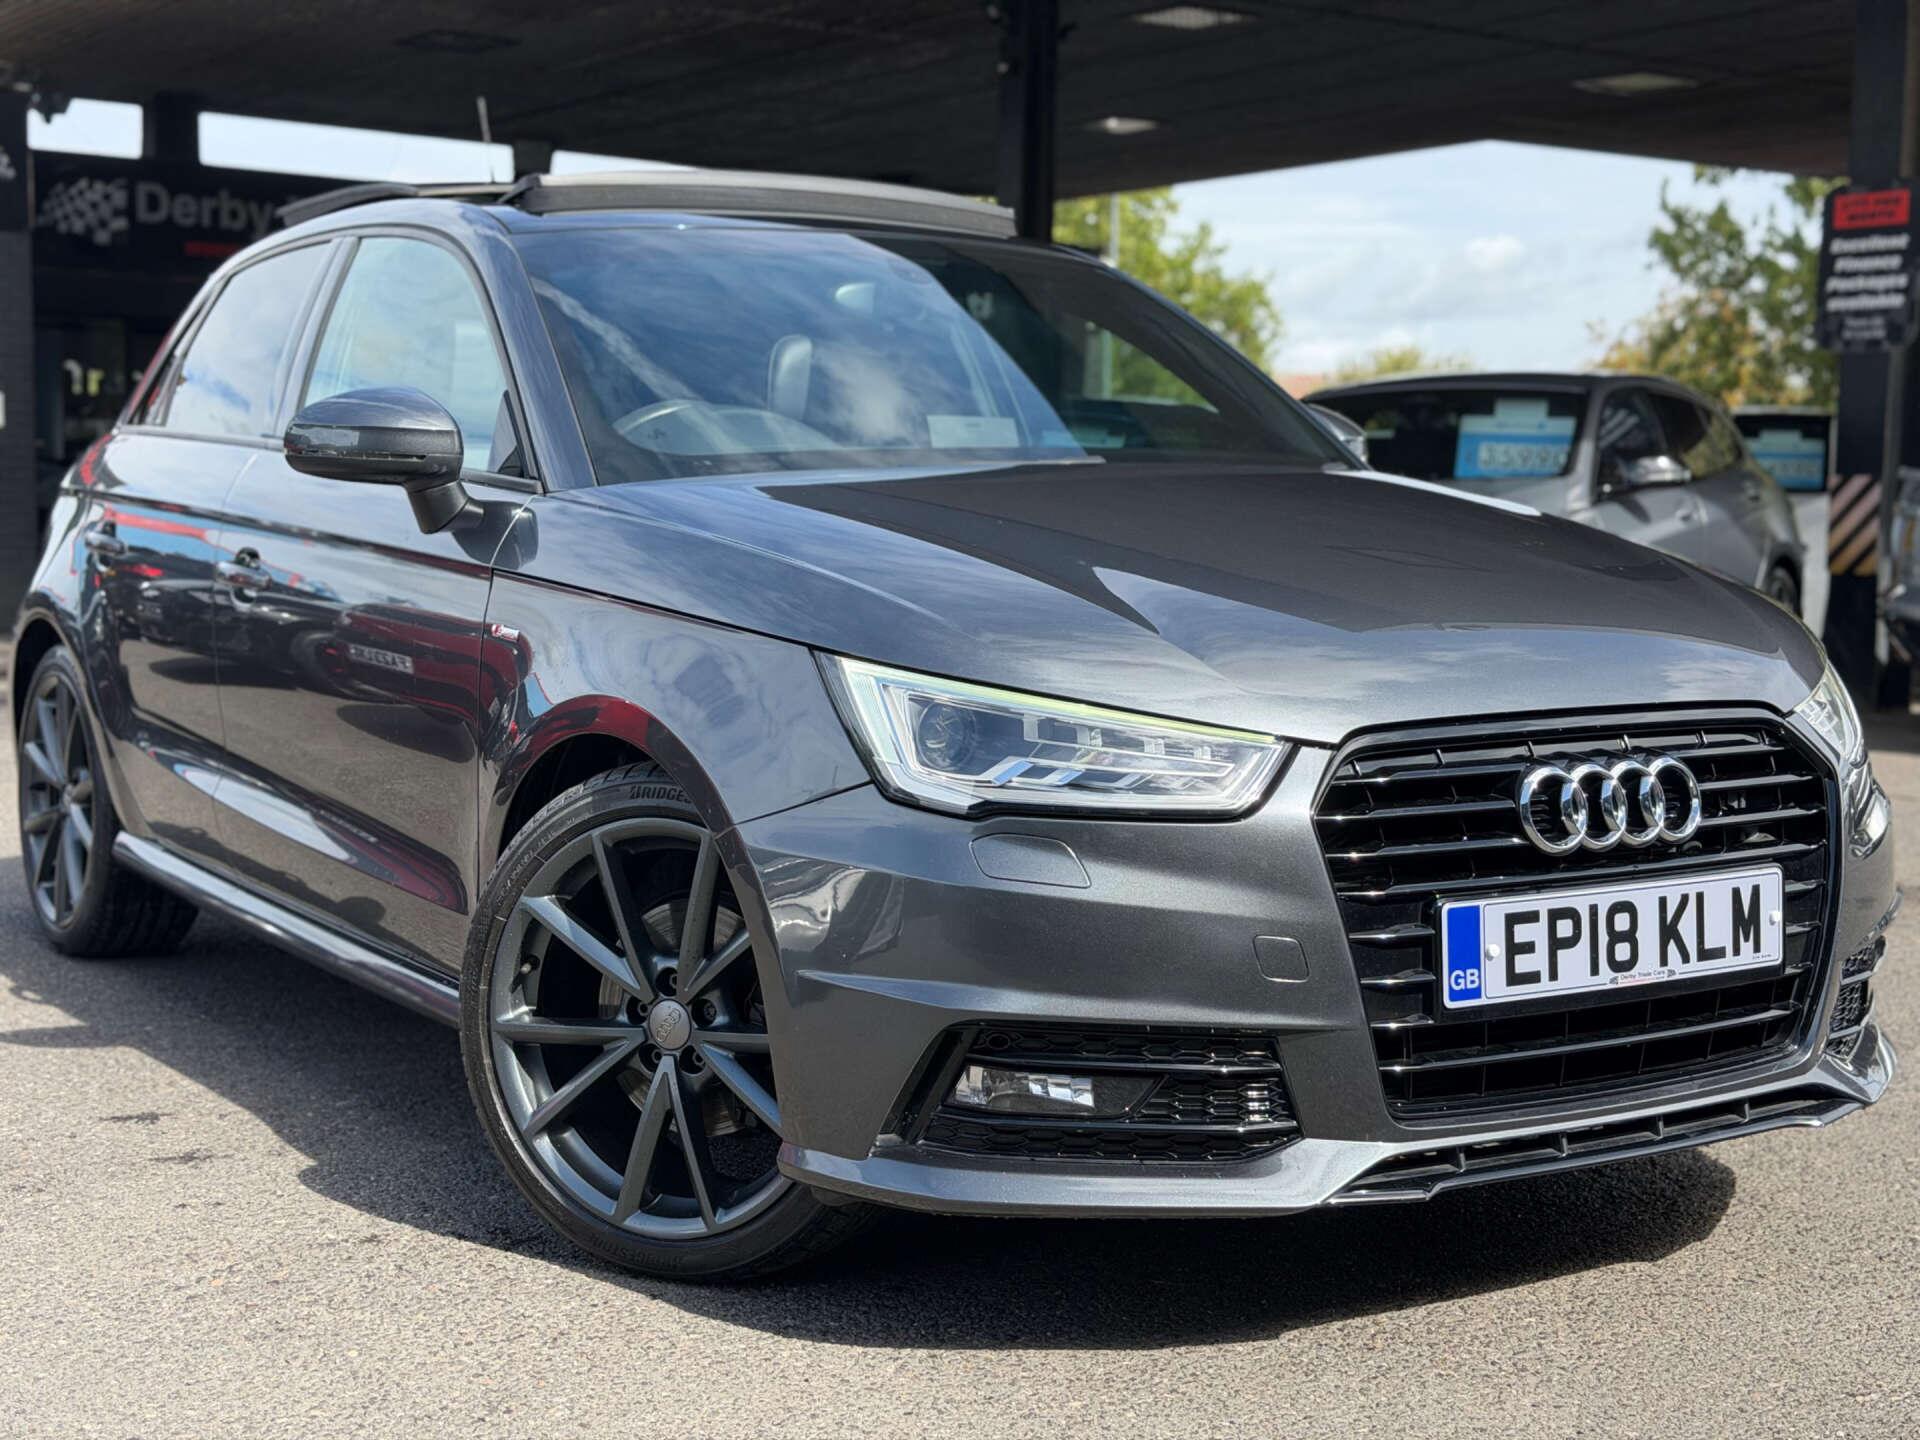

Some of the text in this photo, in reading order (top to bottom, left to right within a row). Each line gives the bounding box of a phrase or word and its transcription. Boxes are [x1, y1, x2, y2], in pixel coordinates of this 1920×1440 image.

[136, 182, 274, 239] Derby
[1504, 883, 1762, 988] EP18 KLM
[1449, 968, 1481, 991] GB
